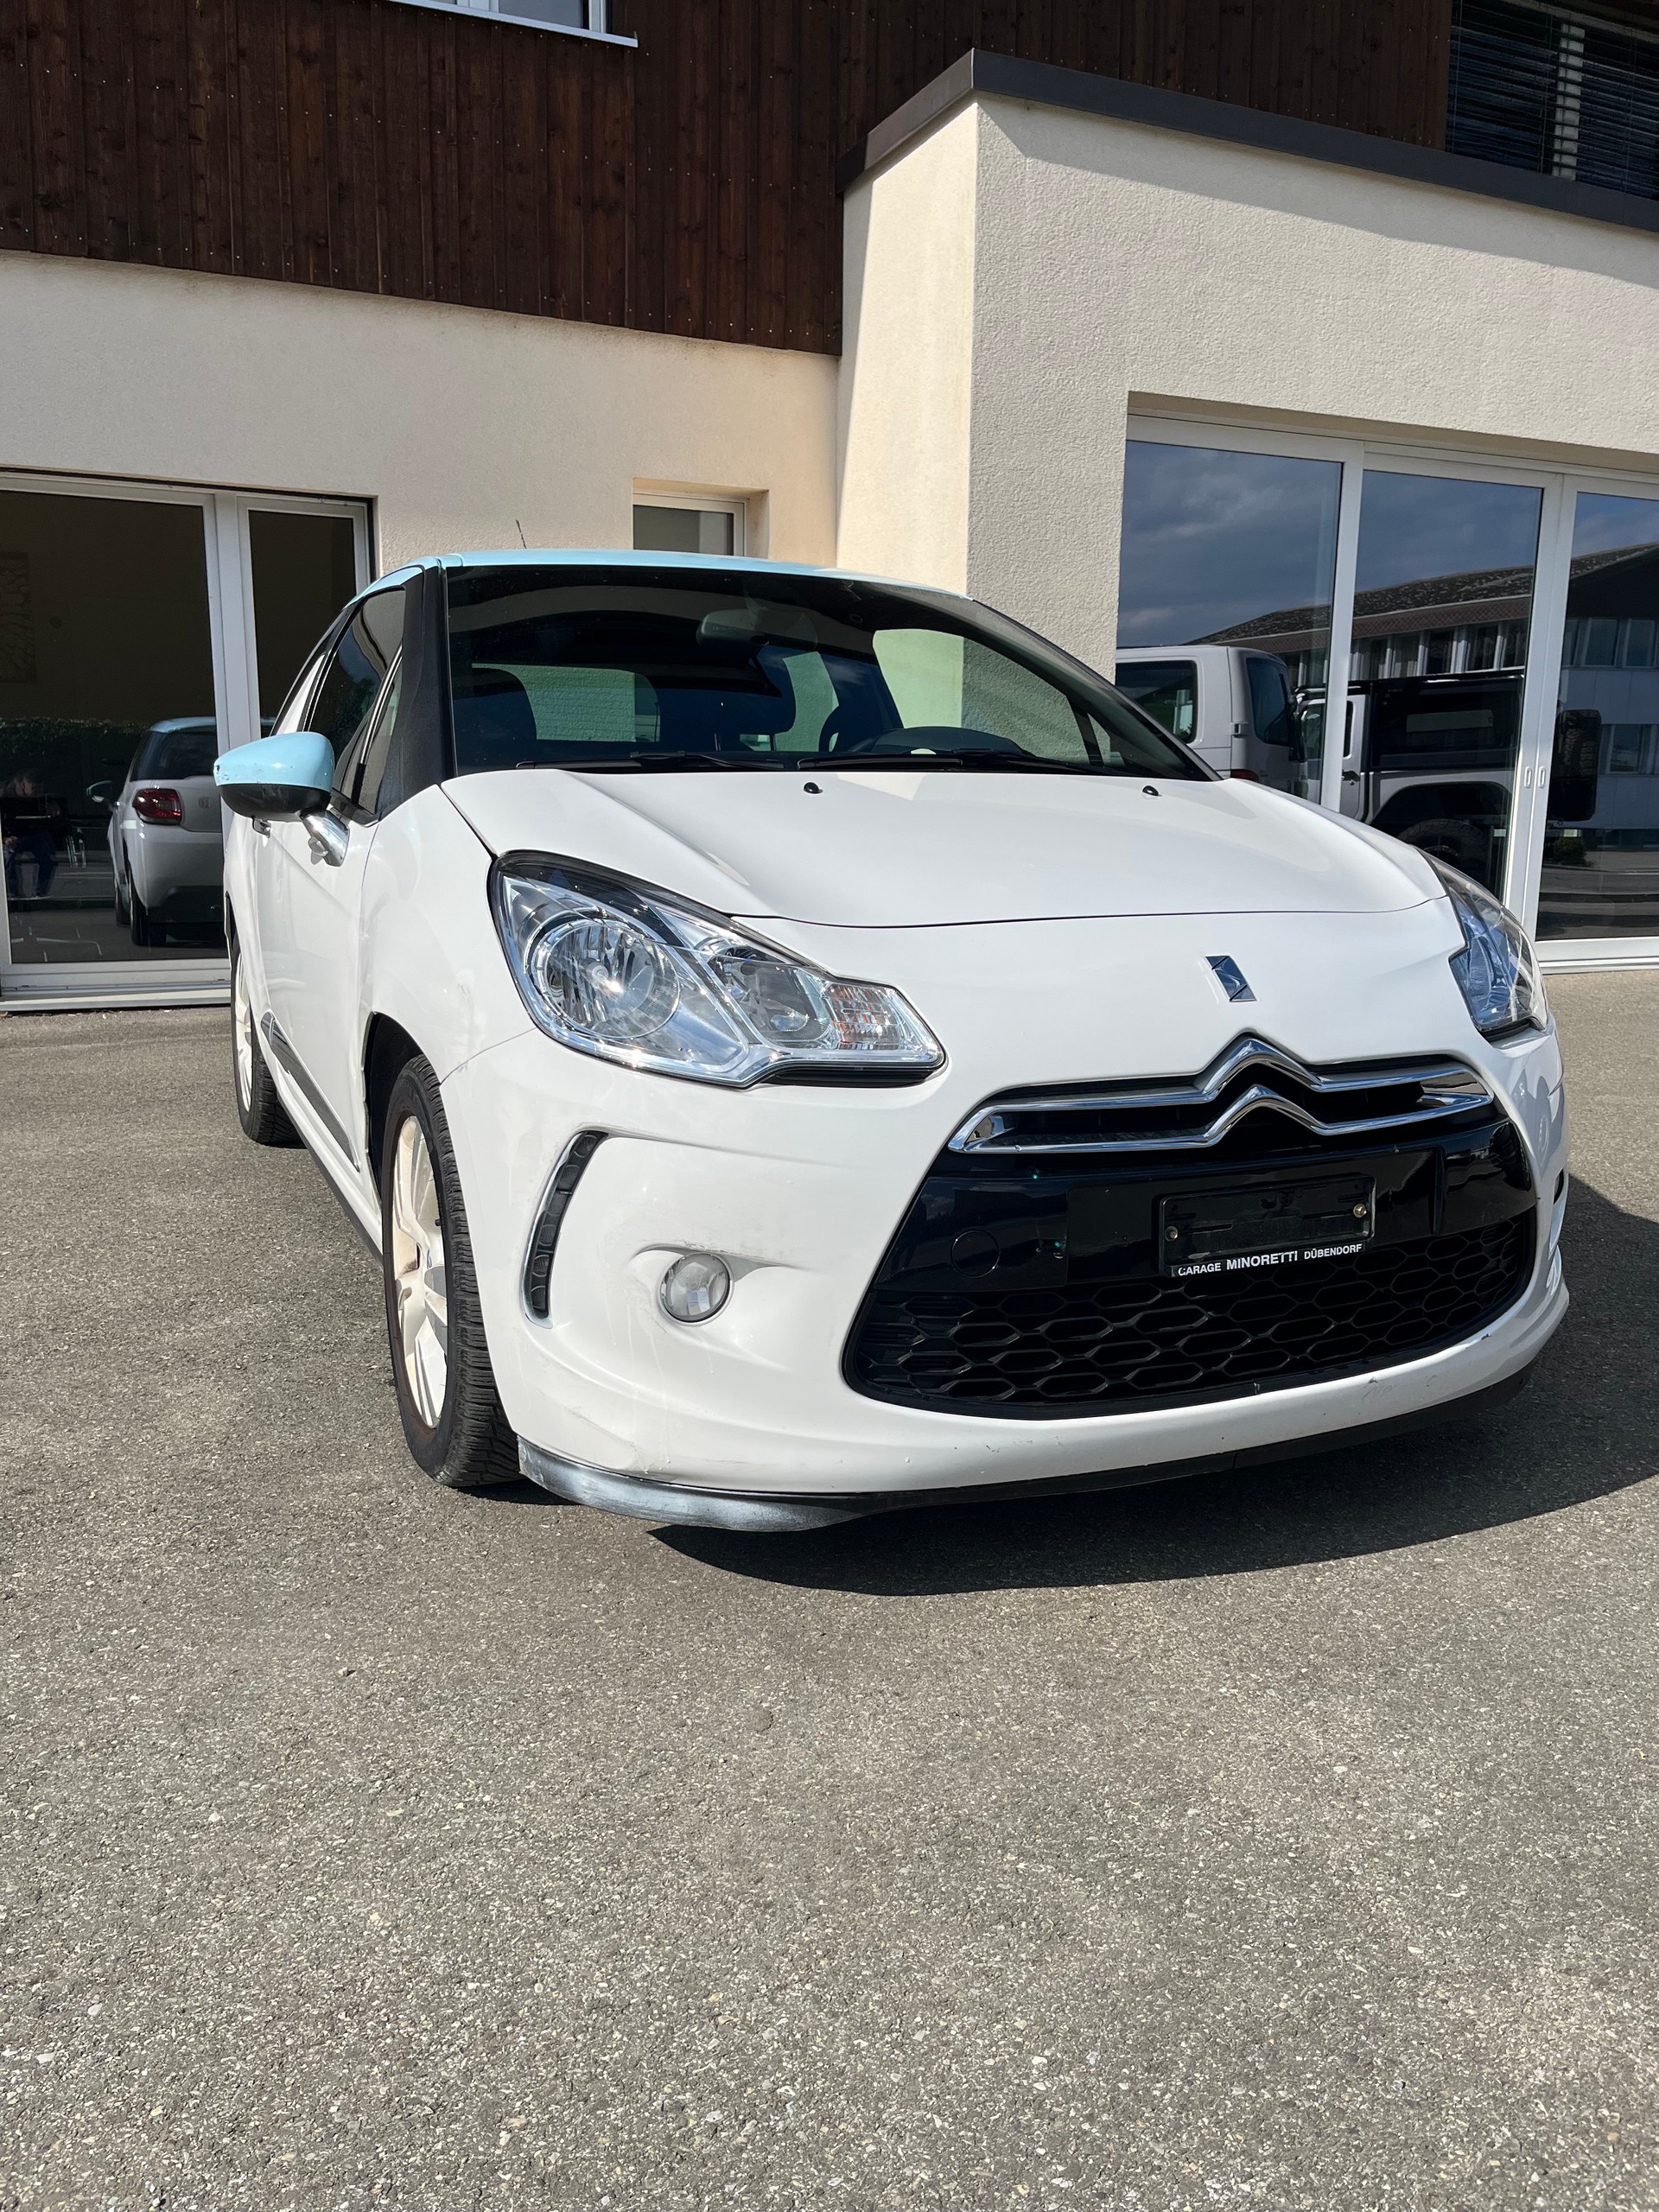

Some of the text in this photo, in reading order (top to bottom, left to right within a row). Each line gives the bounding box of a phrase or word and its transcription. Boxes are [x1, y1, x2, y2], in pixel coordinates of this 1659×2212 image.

[1178, 1243, 1363, 1276] GARAGE MINORETTI DÜBENDORF
